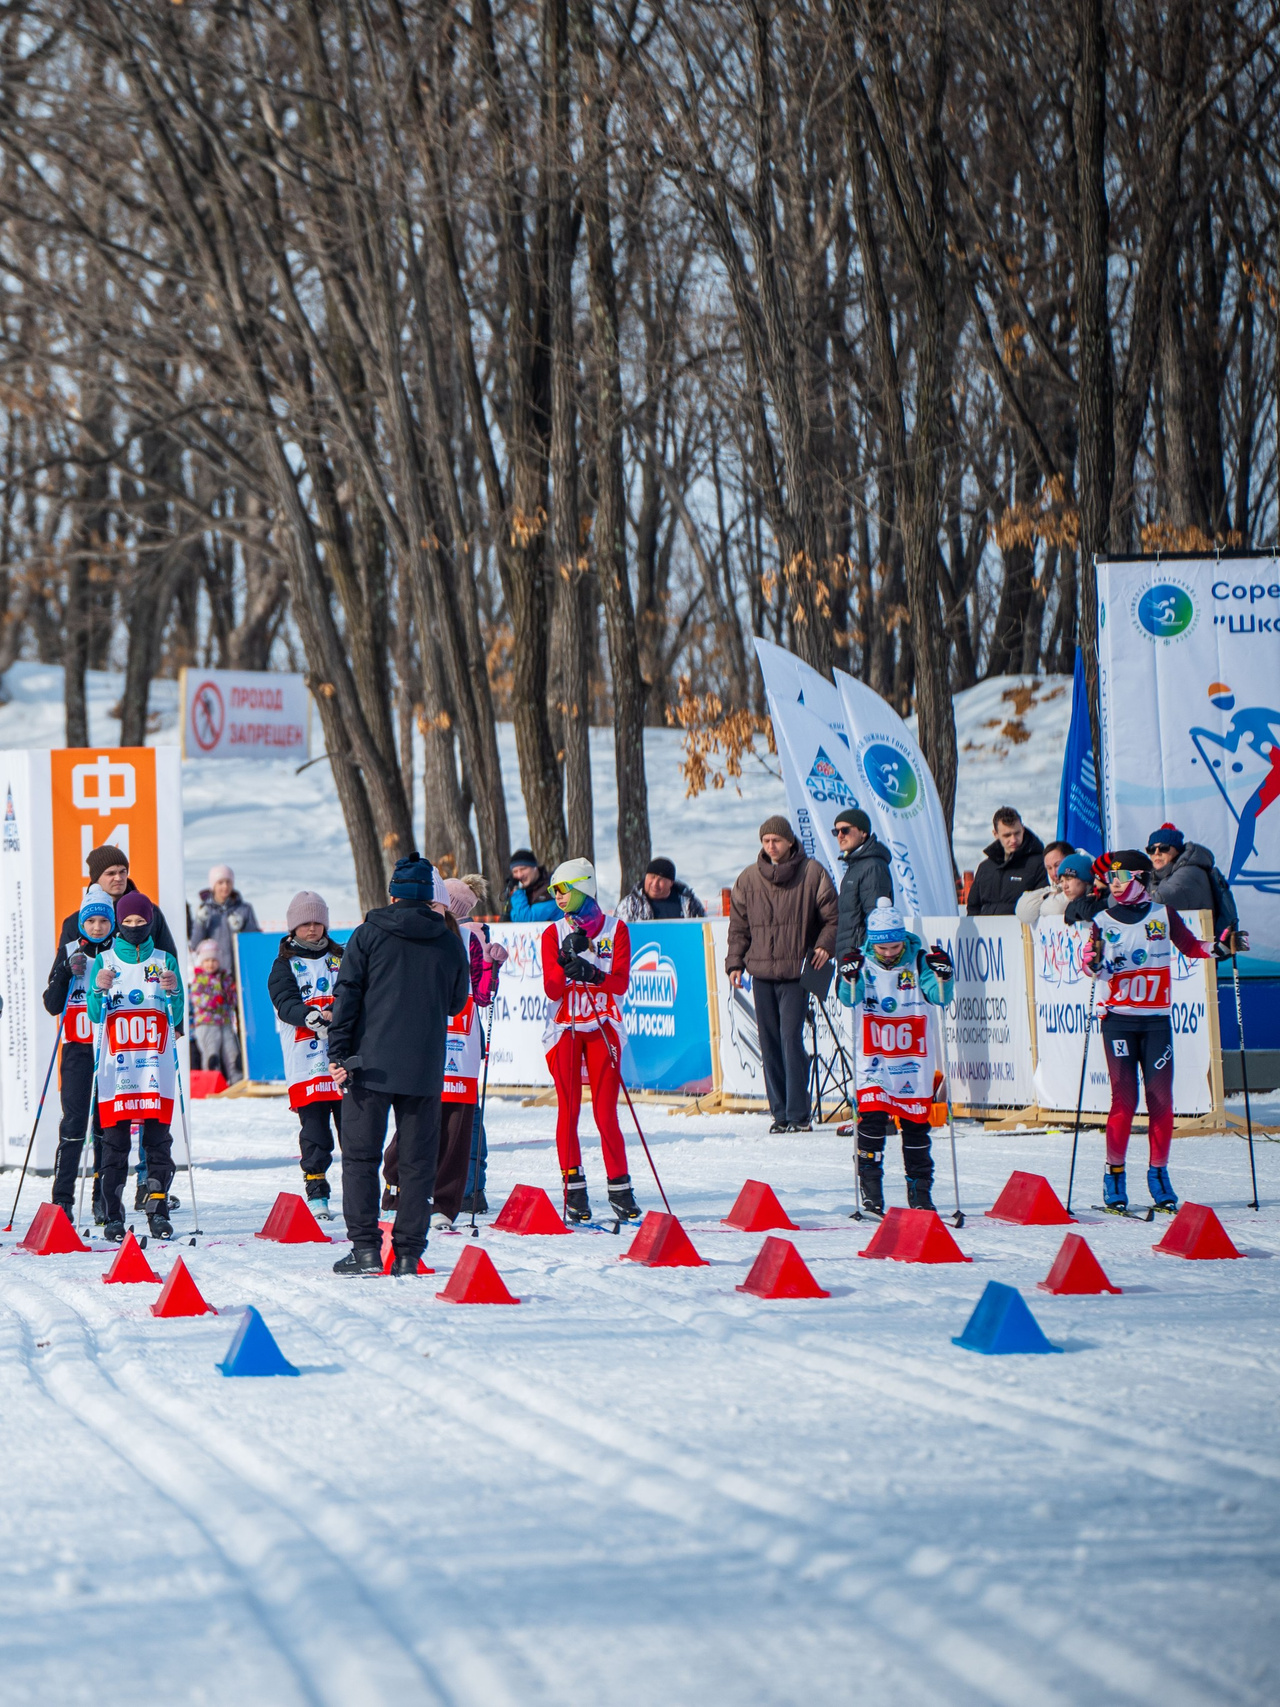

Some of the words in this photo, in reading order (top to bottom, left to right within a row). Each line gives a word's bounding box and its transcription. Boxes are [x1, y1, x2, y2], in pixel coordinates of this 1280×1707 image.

[1211, 581, 1280, 604] Соре
[230, 686, 283, 711] ПРОХОД
[229, 721, 303, 748] ЗАПРЕЩЕН
[1113, 975, 1161, 1002] 007
[1164, 987, 1169, 1003] 1
[611, 1005, 619, 1020] 1
[944, 997, 1007, 1025] ОИЗВОДСТВО
[1040, 1003, 1103, 1034] "ШКОЛЬН
[115, 1016, 157, 1044] 005
[639, 1013, 675, 1037] РОССИИ
[870, 1021, 912, 1051] 006
[917, 1037, 925, 1053] 1
[944, 1025, 1011, 1043] ЕТАЛЛОКОНСТРУКЦИЙ
